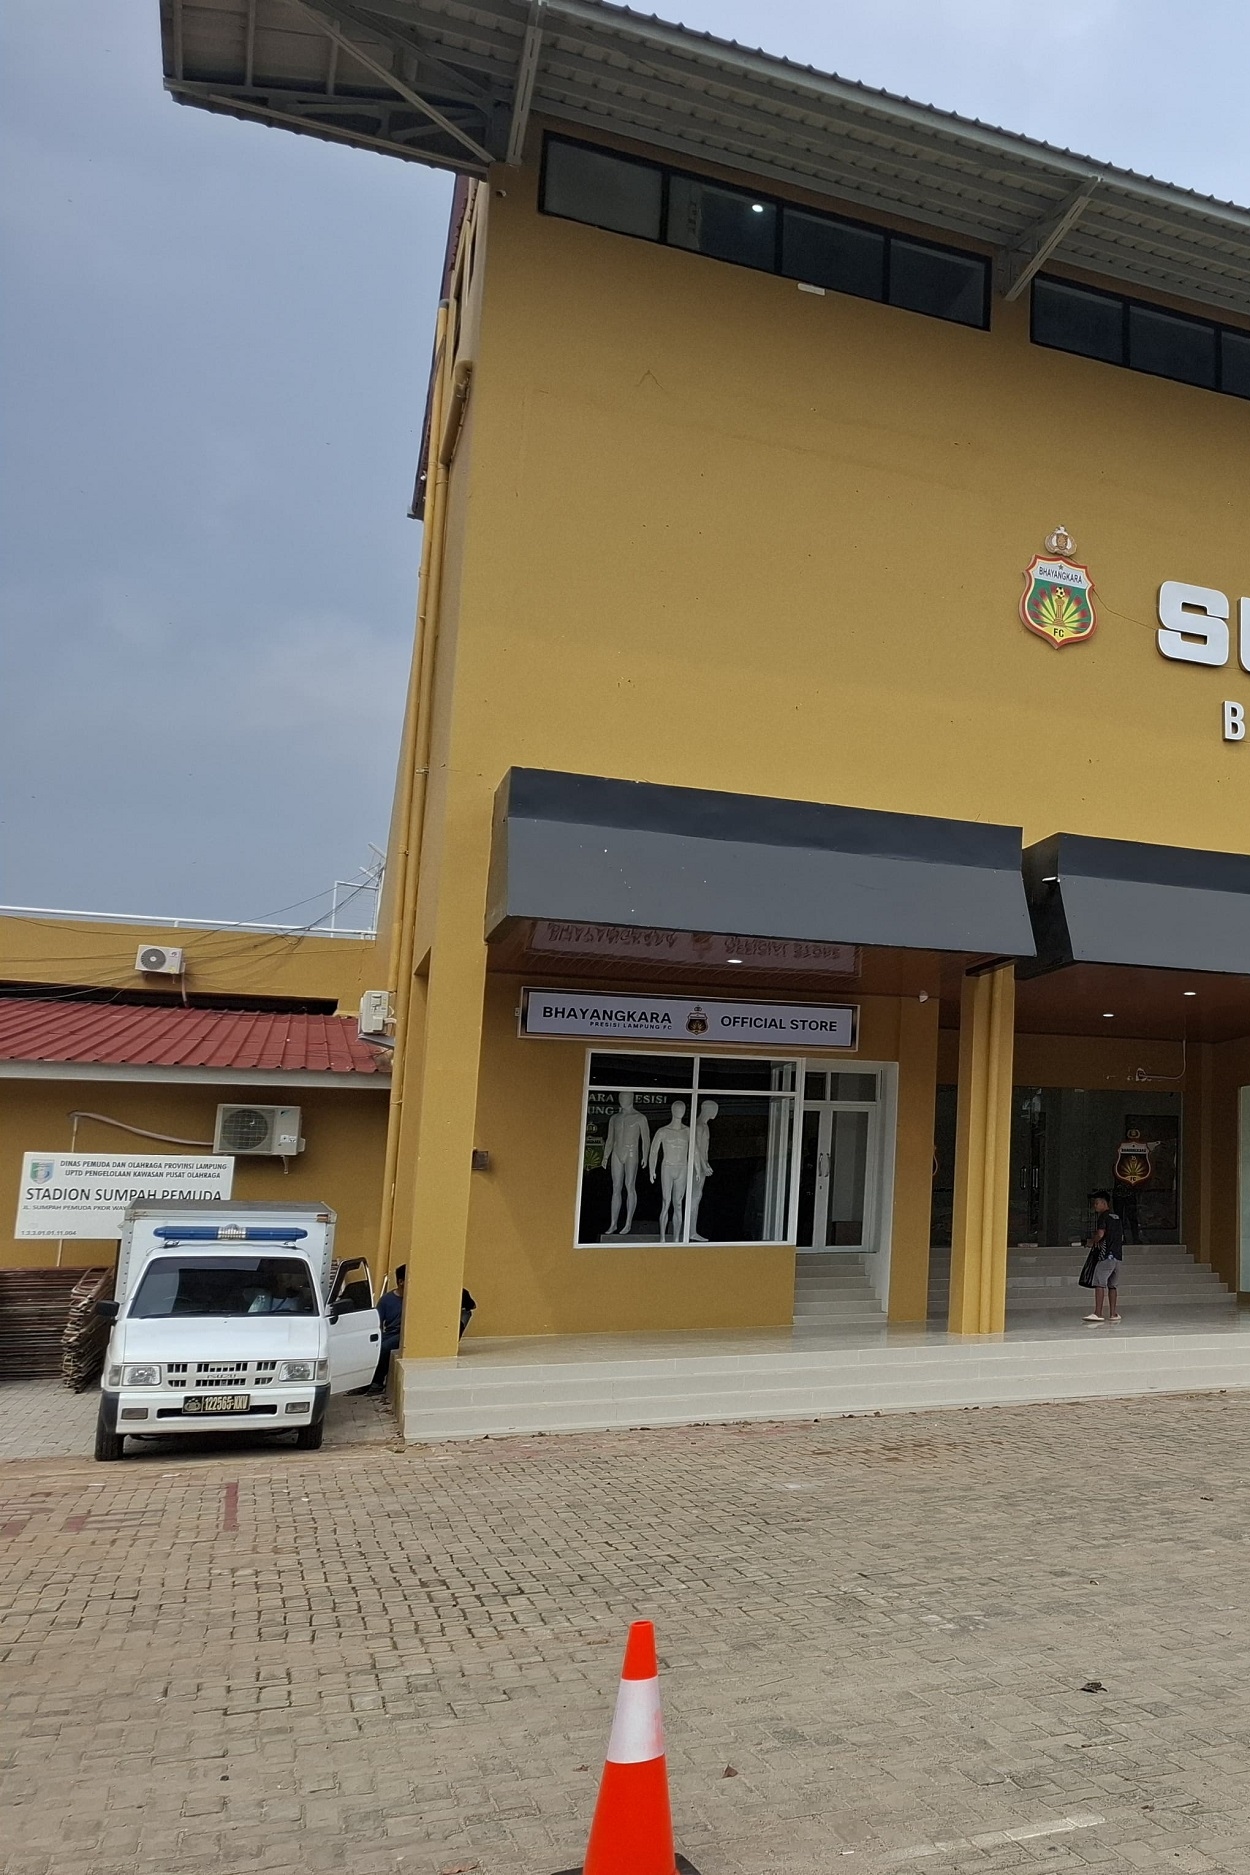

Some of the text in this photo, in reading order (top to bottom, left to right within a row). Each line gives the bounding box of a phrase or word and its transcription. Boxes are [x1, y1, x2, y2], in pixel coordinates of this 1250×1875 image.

[1038, 567, 1083, 584] BHAYANGKARA
[1053, 627, 1065, 638] FC
[542, 1006, 673, 1024] BHAYANGKARA
[720, 1015, 838, 1032] OFFICIAL STORE
[634, 1094, 667, 1104] ESISI
[60, 1160, 81, 1168] DINAS
[82, 1160, 111, 1168] PEMUDA
[163, 1162, 194, 1170] PROVINSI
[25, 1187, 222, 1201] STADION SUMPAH PEMUDA
[205, 1396, 248, 1411] 122565-XXV
